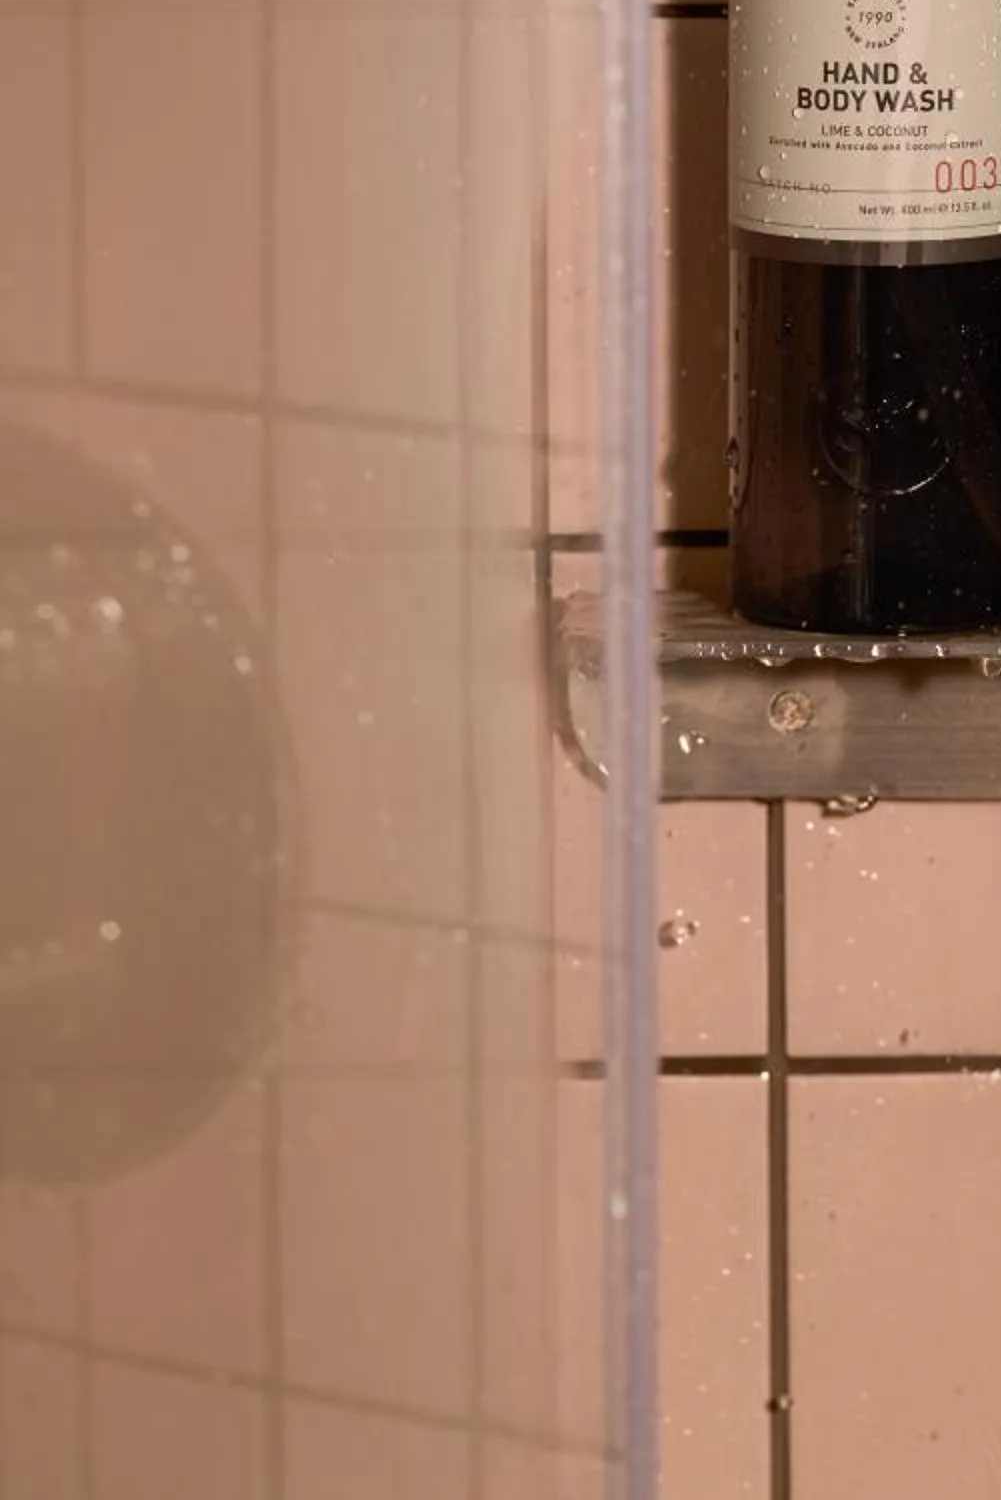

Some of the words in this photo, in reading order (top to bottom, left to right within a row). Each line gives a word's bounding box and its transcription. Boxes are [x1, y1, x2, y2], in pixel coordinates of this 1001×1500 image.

[859, 11, 893, 25] 1990
[823, 61, 899, 85] HAND
[909, 62, 928, 85] &
[797, 88, 867, 112] BODY
[875, 90, 954, 112] WASH
[821, 125, 850, 137] LIME
[855, 126, 863, 137] &
[867, 125, 928, 137] COCONUT
[935, 156, 998, 192] 003
